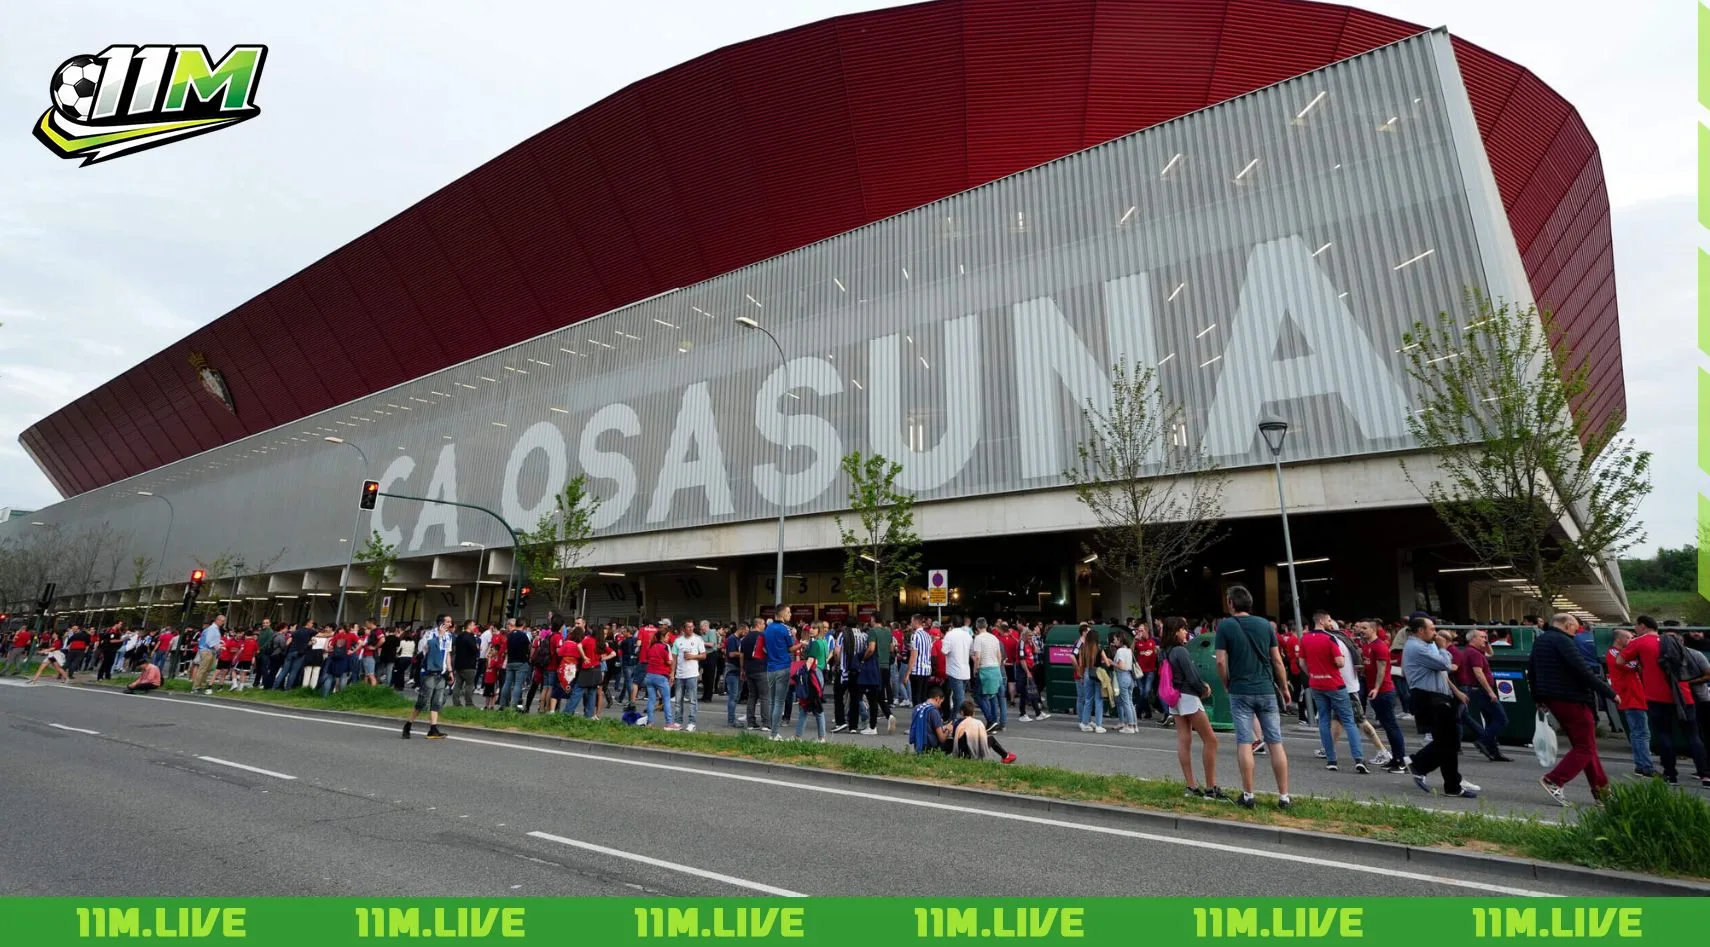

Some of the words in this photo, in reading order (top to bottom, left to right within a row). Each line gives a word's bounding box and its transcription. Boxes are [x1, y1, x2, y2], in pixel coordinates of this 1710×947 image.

[370, 443, 459, 552] CA
[501, 234, 1413, 538] OSASUNA
[831, 576, 841, 594] 2
